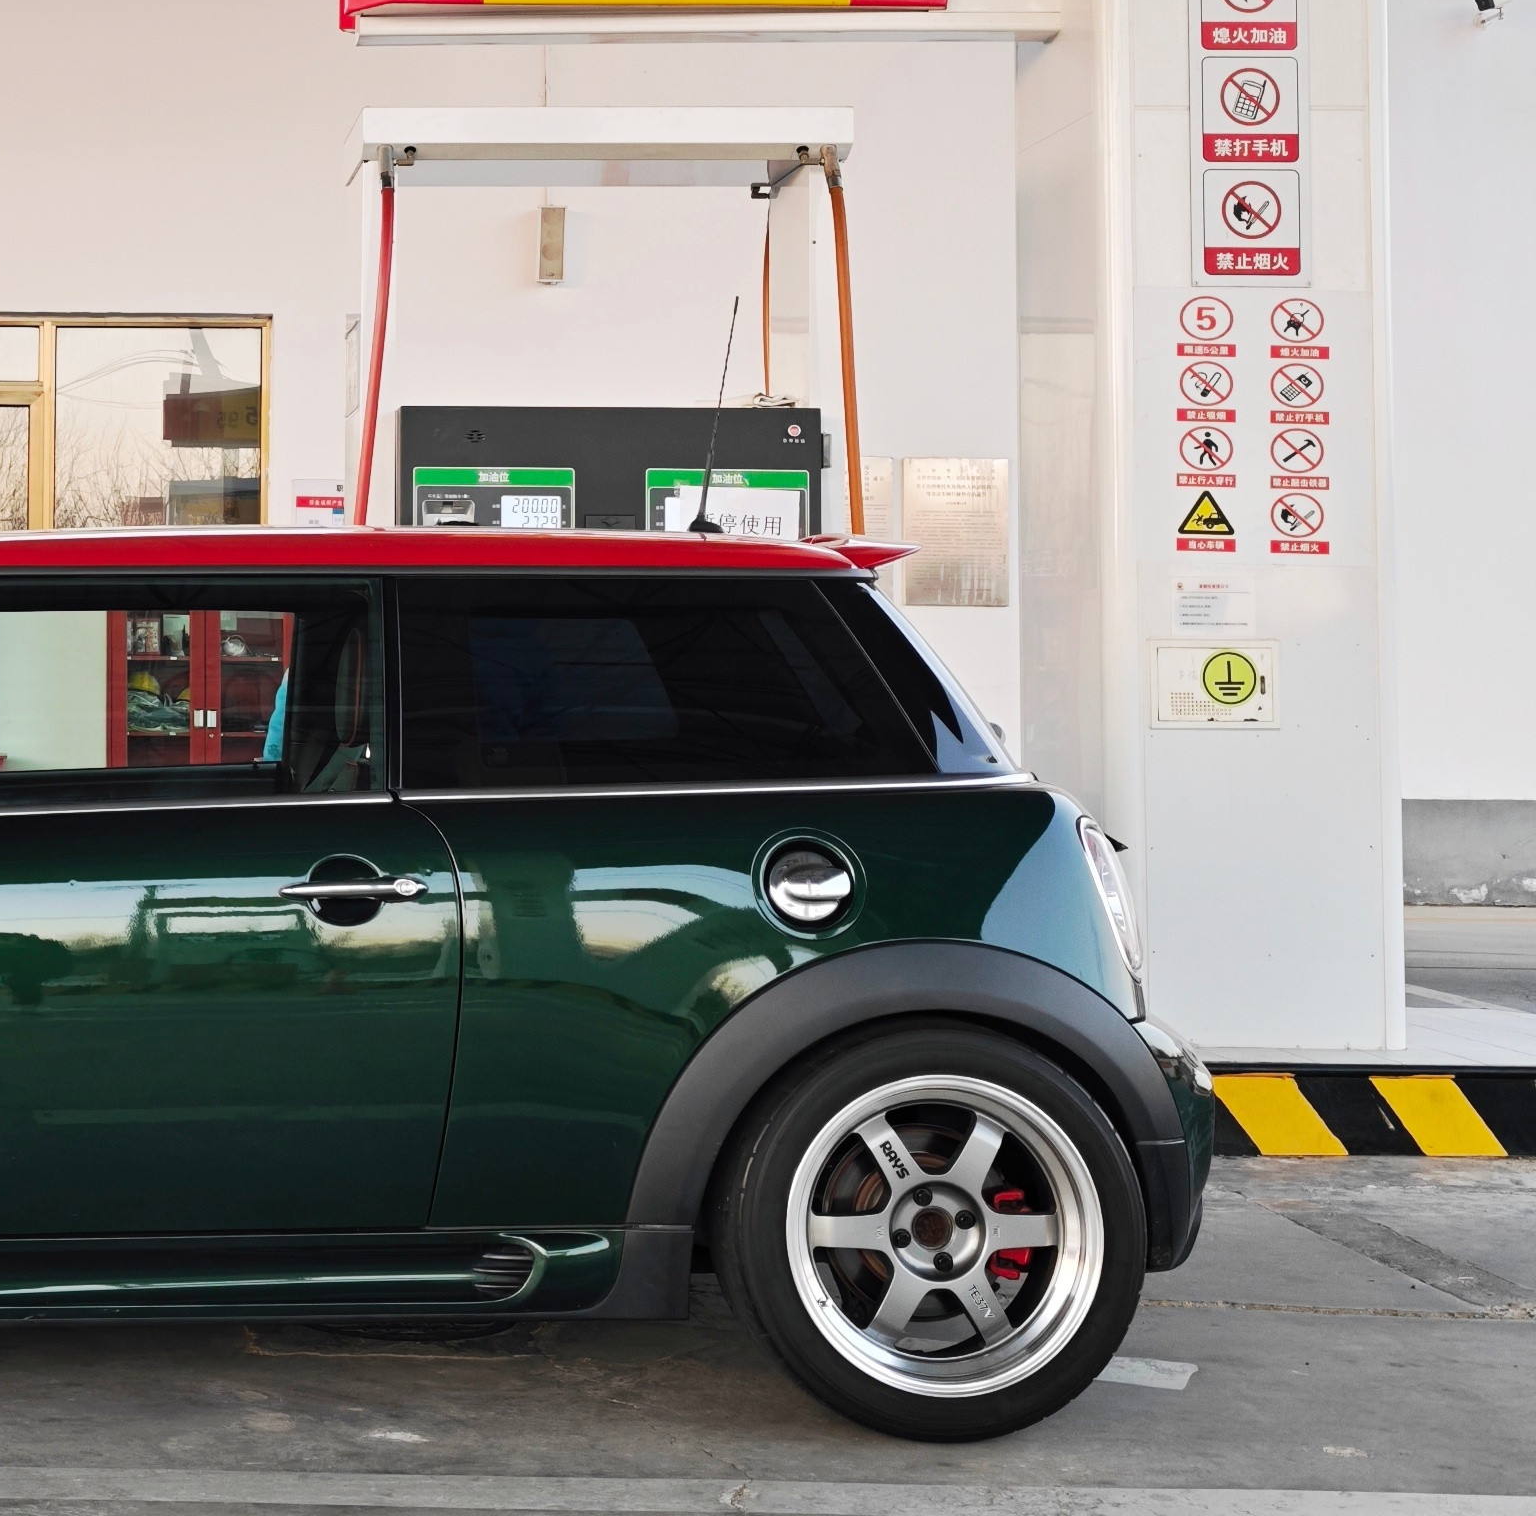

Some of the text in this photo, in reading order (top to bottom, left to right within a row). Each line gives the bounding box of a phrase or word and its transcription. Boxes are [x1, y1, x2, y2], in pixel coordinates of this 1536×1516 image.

[1212, 27, 1287, 45] 熄火加油
[1214, 138, 1289, 158] 禁打手机
[1216, 252, 1290, 271] 禁止烟火
[1196, 306, 1217, 332] 5
[478, 471, 510, 483] 加油位
[711, 473, 744, 484] 加油位
[879, 1140, 910, 1180] RAYS
